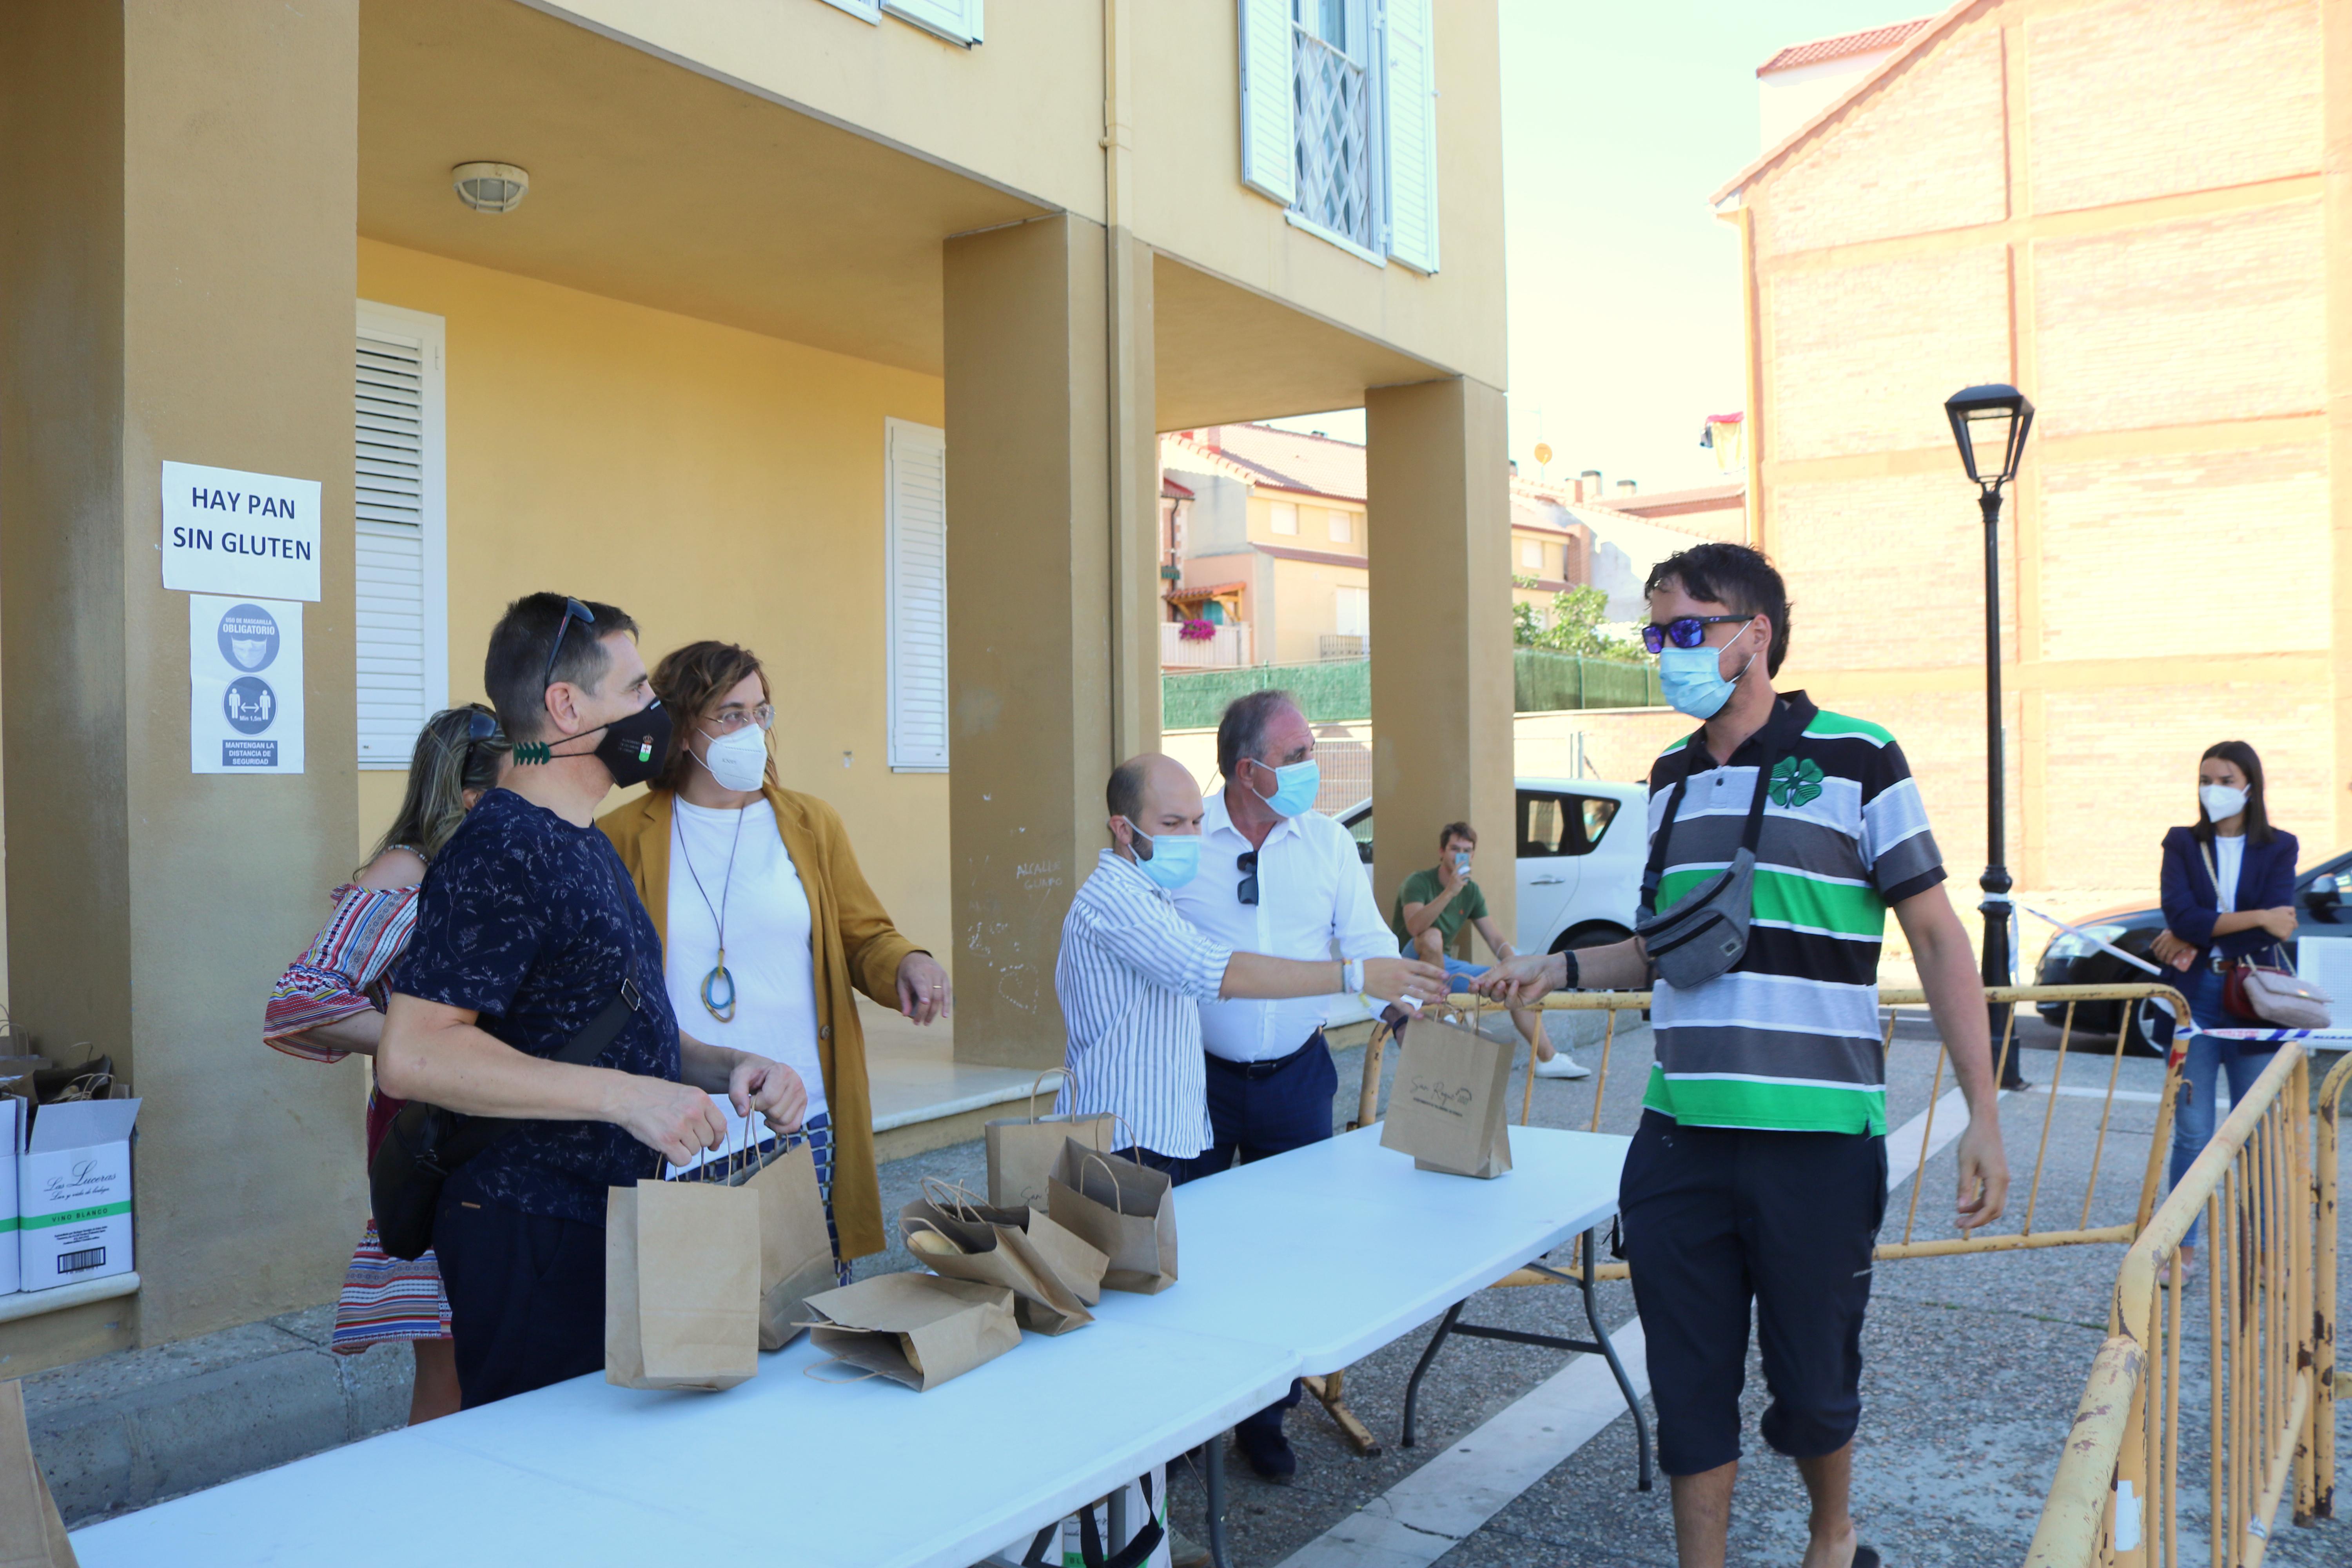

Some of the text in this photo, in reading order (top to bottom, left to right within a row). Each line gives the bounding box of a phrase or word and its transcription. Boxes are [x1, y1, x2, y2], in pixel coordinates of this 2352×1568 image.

[192, 487, 294, 519] HAY PAN
[173, 526, 310, 561] SIN GLUTEN
[223, 623, 275, 635] OBLIGATORIO
[43, 1160, 116, 1192] Las Luceras
[52, 1208, 108, 1222] VINO BLANCO
